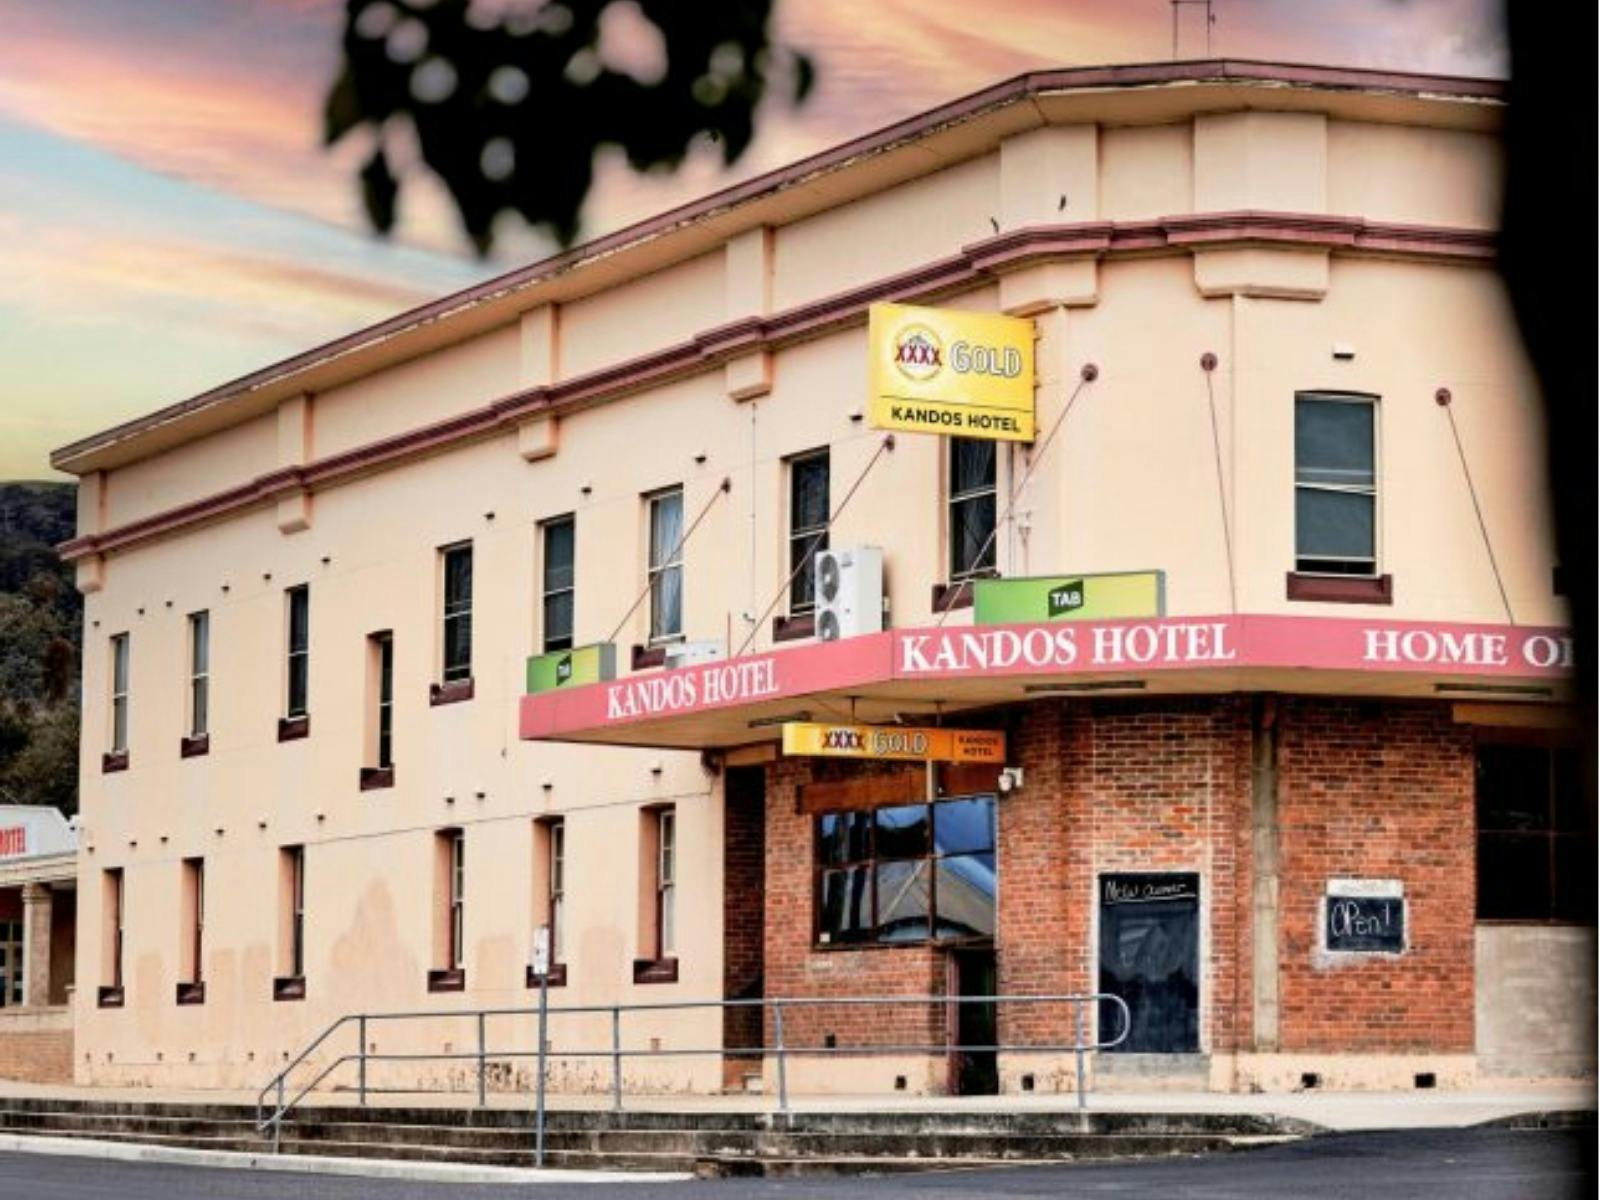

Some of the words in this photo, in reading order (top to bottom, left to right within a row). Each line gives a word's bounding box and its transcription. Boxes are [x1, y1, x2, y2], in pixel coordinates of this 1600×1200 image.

[894, 344, 942, 366] XXXX
[951, 341, 1021, 378] GOLD
[891, 406, 963, 426] KANDOS
[968, 413, 1021, 433] HOTEL
[1052, 592, 1081, 606] TAB
[901, 626, 1078, 673] KANDOS
[1091, 622, 1236, 665] HOTEL
[1363, 629, 1508, 666] HOME
[607, 672, 697, 719] KANDOS
[702, 658, 779, 705] HOTEL
[821, 729, 866, 750] XXXX
